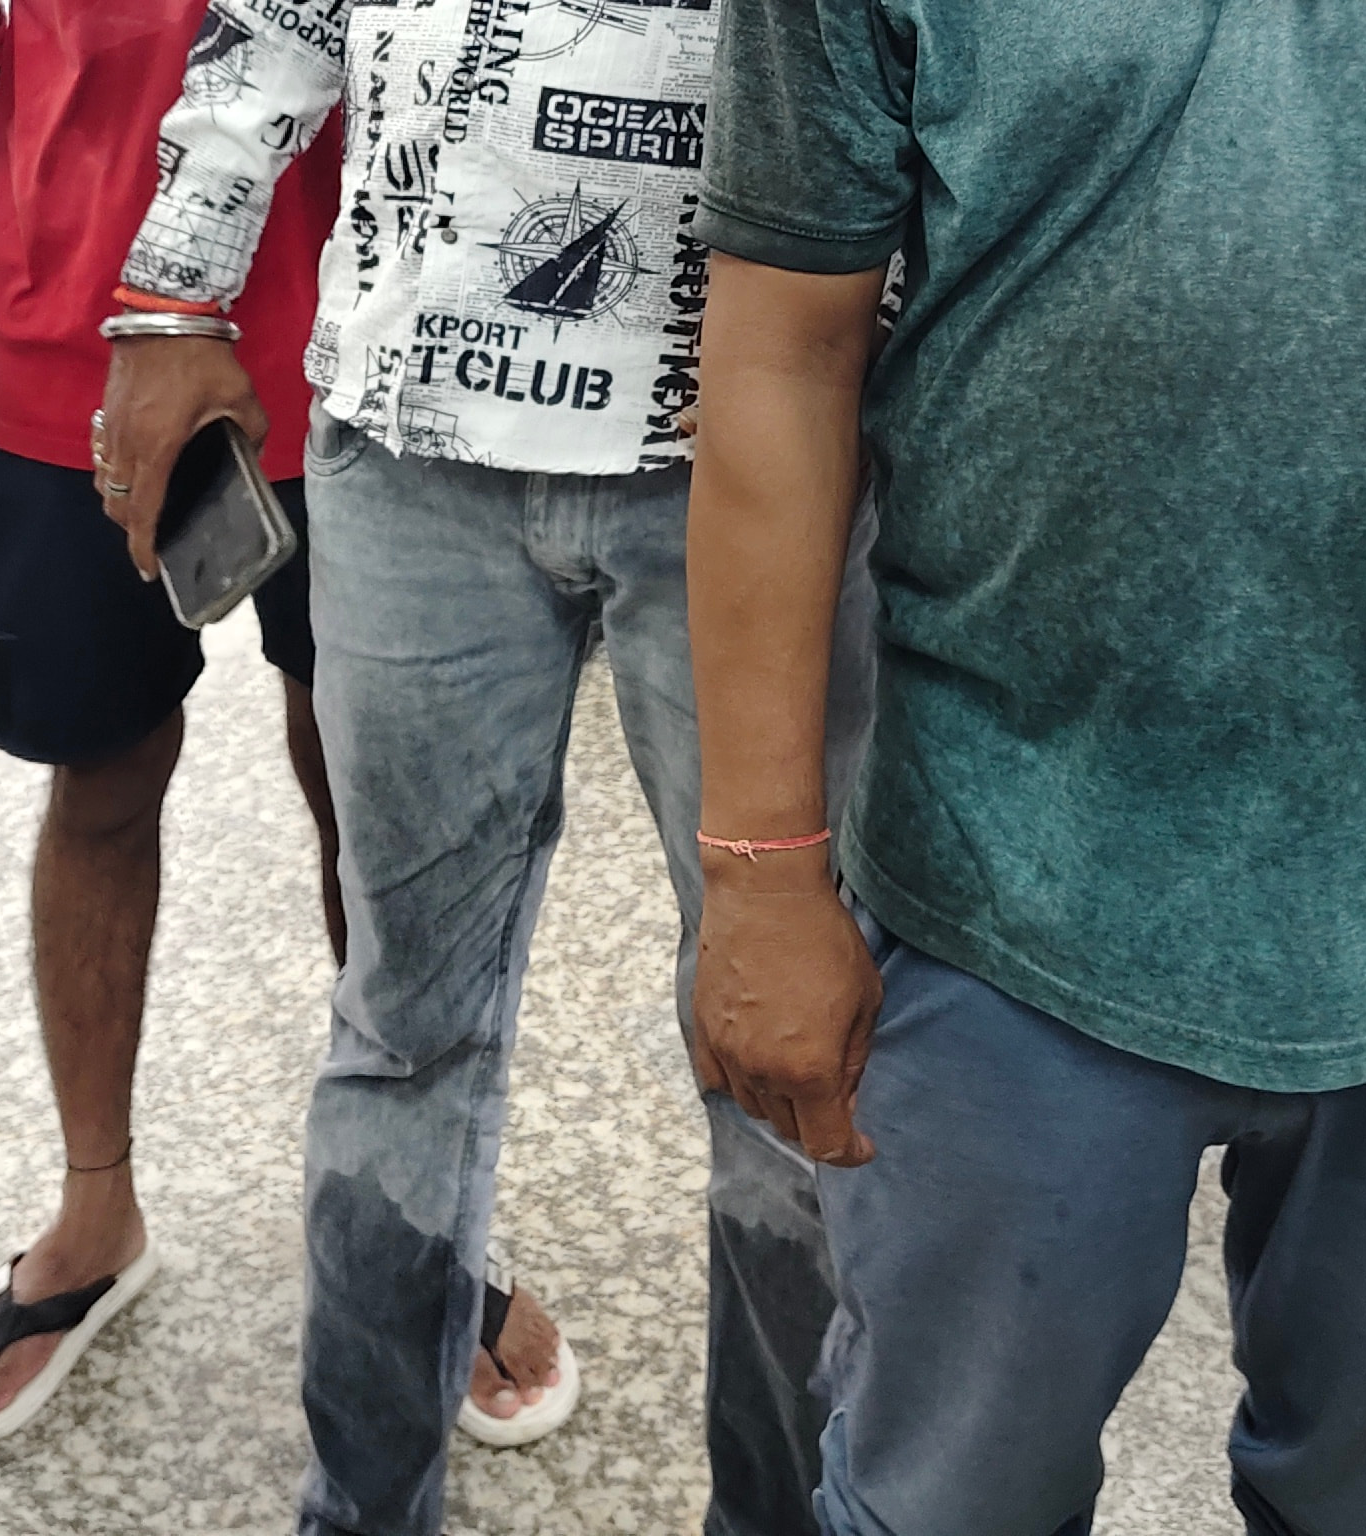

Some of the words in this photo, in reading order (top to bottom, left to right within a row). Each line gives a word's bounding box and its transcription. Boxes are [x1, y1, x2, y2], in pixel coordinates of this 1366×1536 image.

[546, 94, 705, 132] OCEAN
[542, 122, 705, 161] SPIRIT
[455, 348, 613, 410] CLUB
